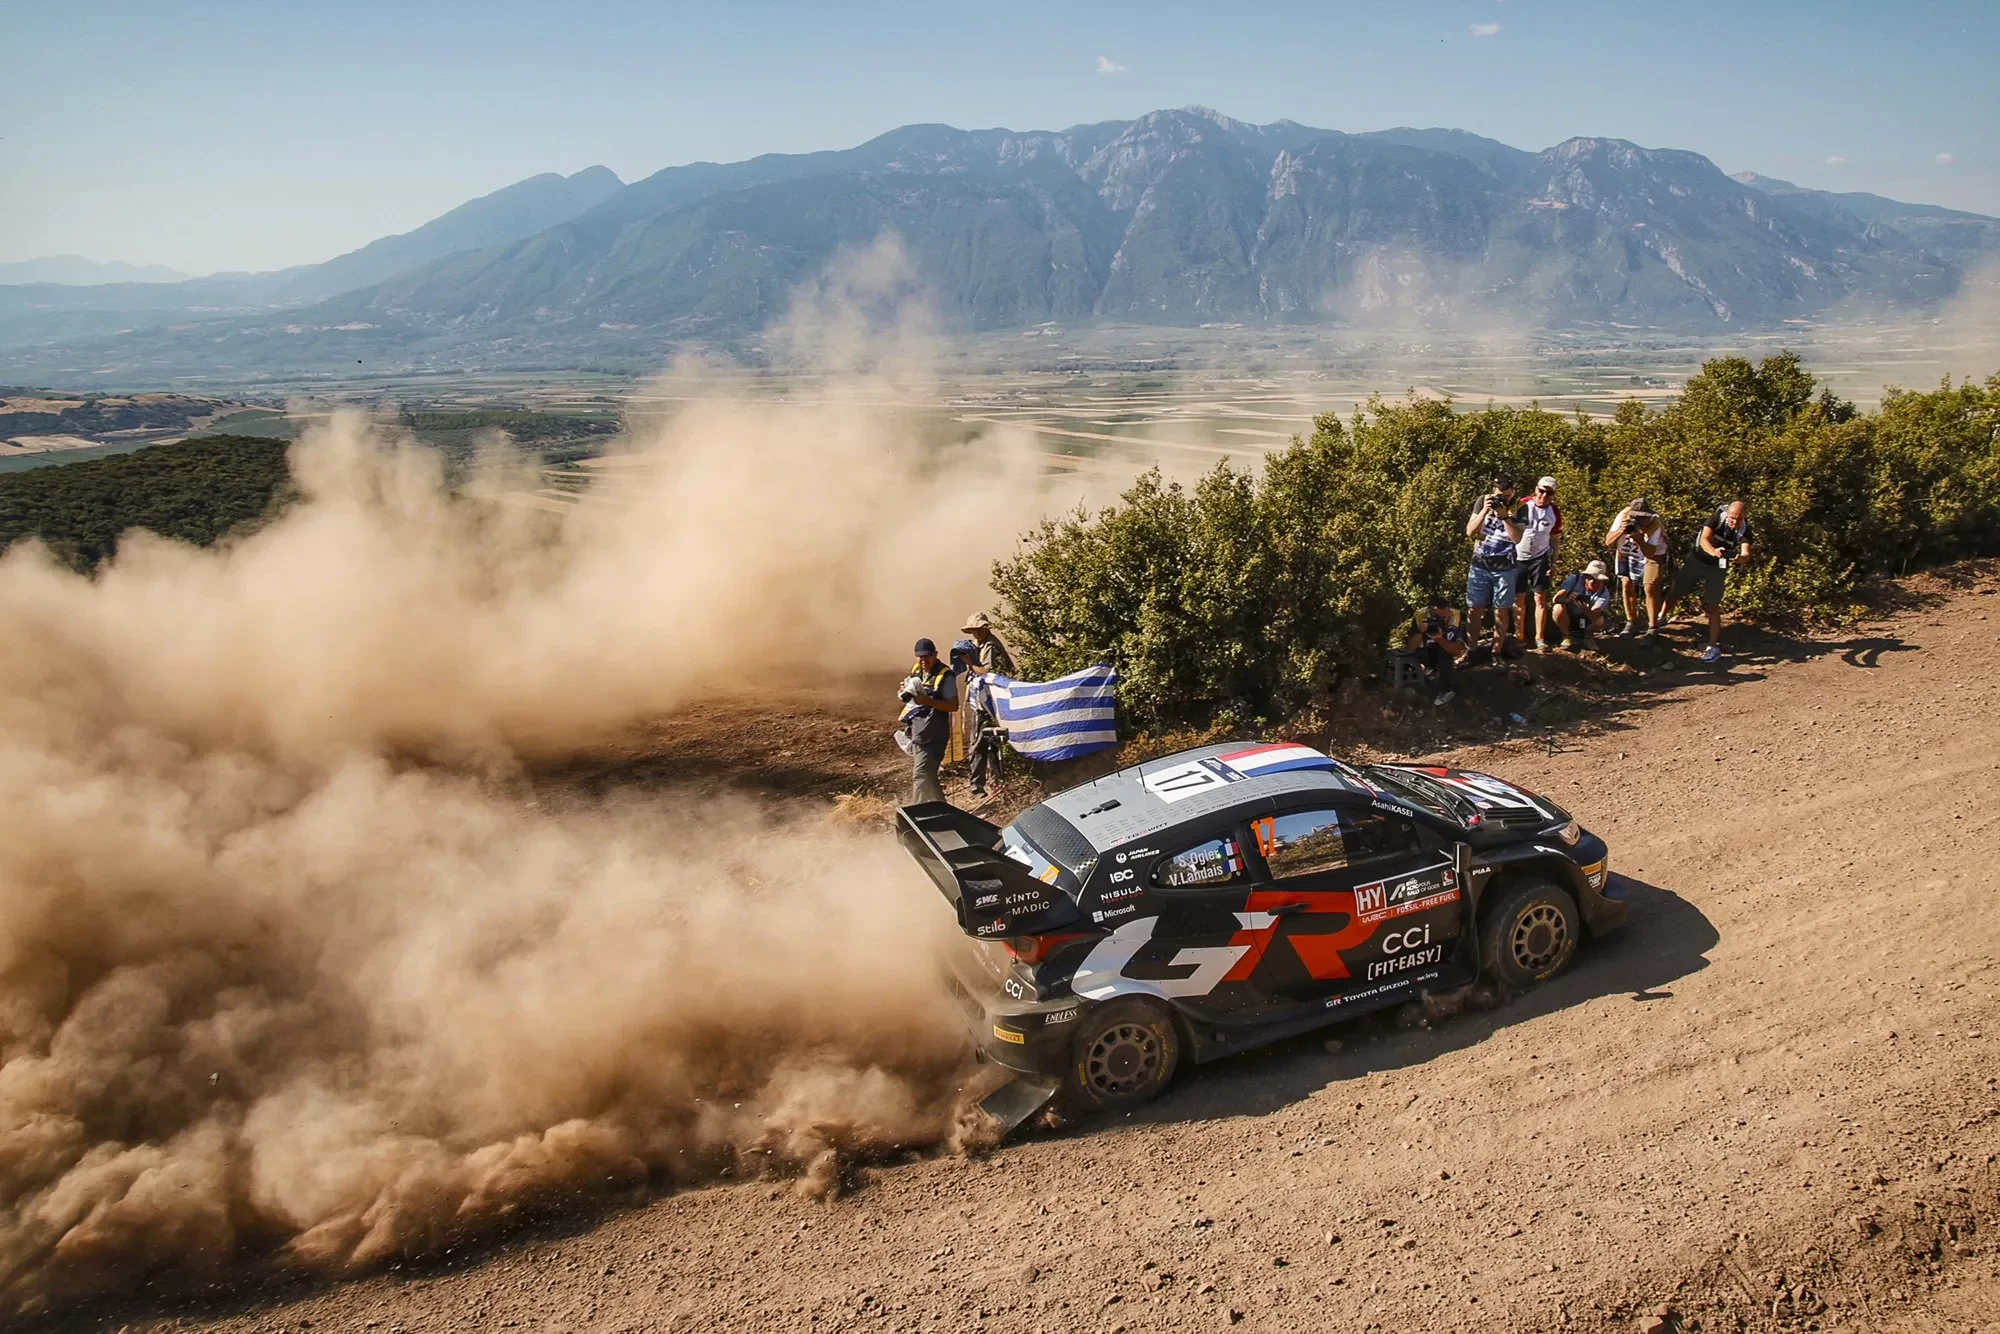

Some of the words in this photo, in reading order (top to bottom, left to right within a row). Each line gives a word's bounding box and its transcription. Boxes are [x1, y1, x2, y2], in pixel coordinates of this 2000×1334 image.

[1153, 770, 1215, 792] 17
[1250, 816, 1276, 857] 17
[1128, 847, 1149, 857] JAPAN
[1130, 849, 1160, 860] AIRLINES
[1179, 848, 1220, 868] S.Ogier
[1169, 864, 1224, 887] V.Landais
[1472, 866, 1491, 876] PIAA
[1100, 885, 1143, 901] NISULA
[1358, 886, 1382, 911] HY
[1104, 904, 1136, 919] Microsoft
[1362, 911, 1387, 923] WRC
[1396, 897, 1439, 915] FOSSIL-FREE
[1440, 892, 1456, 903] FUEL
[977, 920, 1006, 936] Stilo
[1343, 988, 1378, 1003] TOYOTA
[1044, 1008, 1078, 1023] ENDLESS
